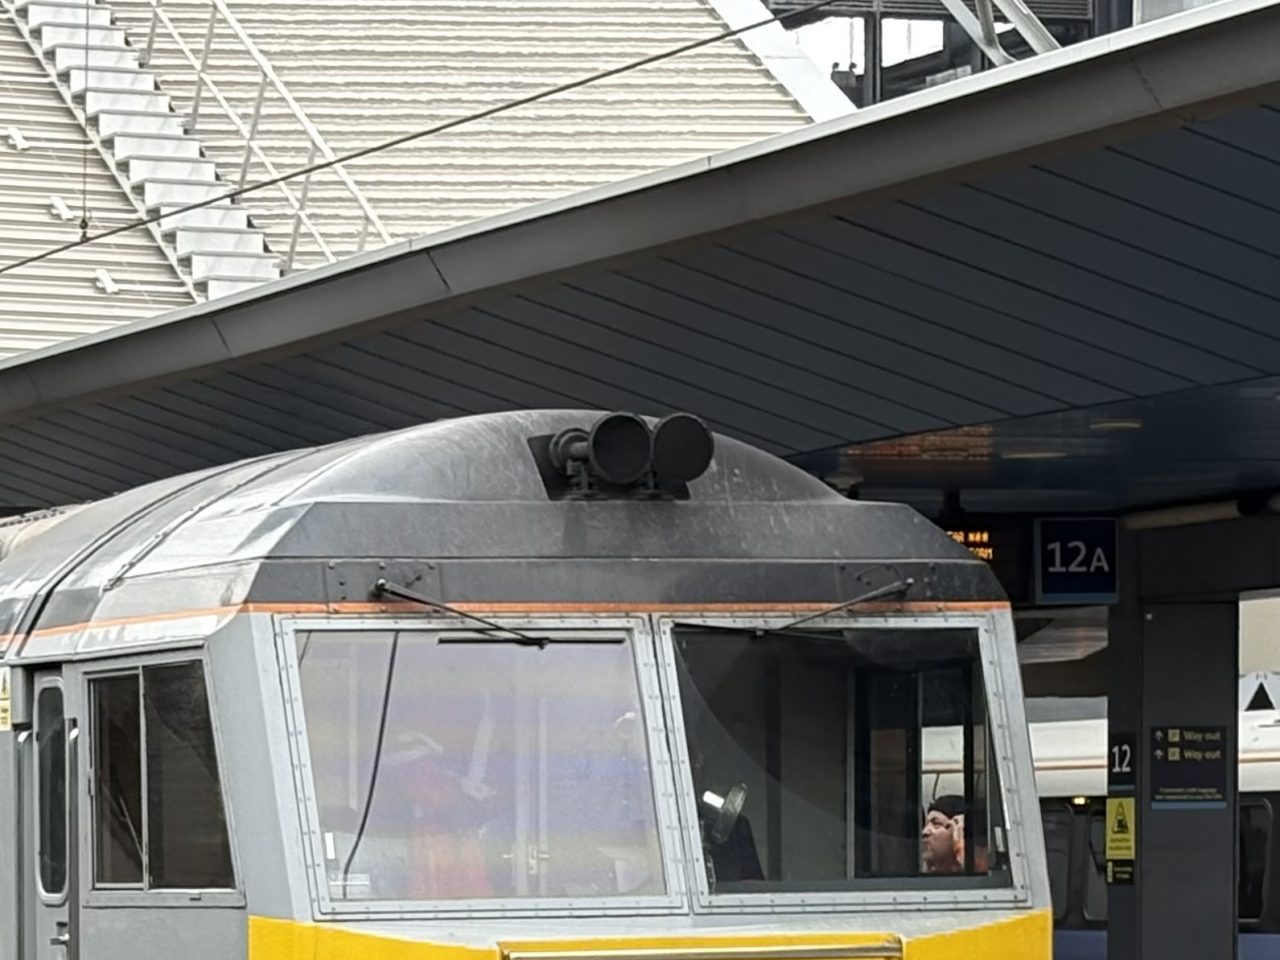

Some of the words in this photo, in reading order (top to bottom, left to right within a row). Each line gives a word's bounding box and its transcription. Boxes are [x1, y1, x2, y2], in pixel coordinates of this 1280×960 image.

[1047, 541, 1109, 572] 12A
[1183, 731, 1202, 742] Way
[1112, 744, 1131, 772] 12
[1183, 749, 1202, 761] Way
